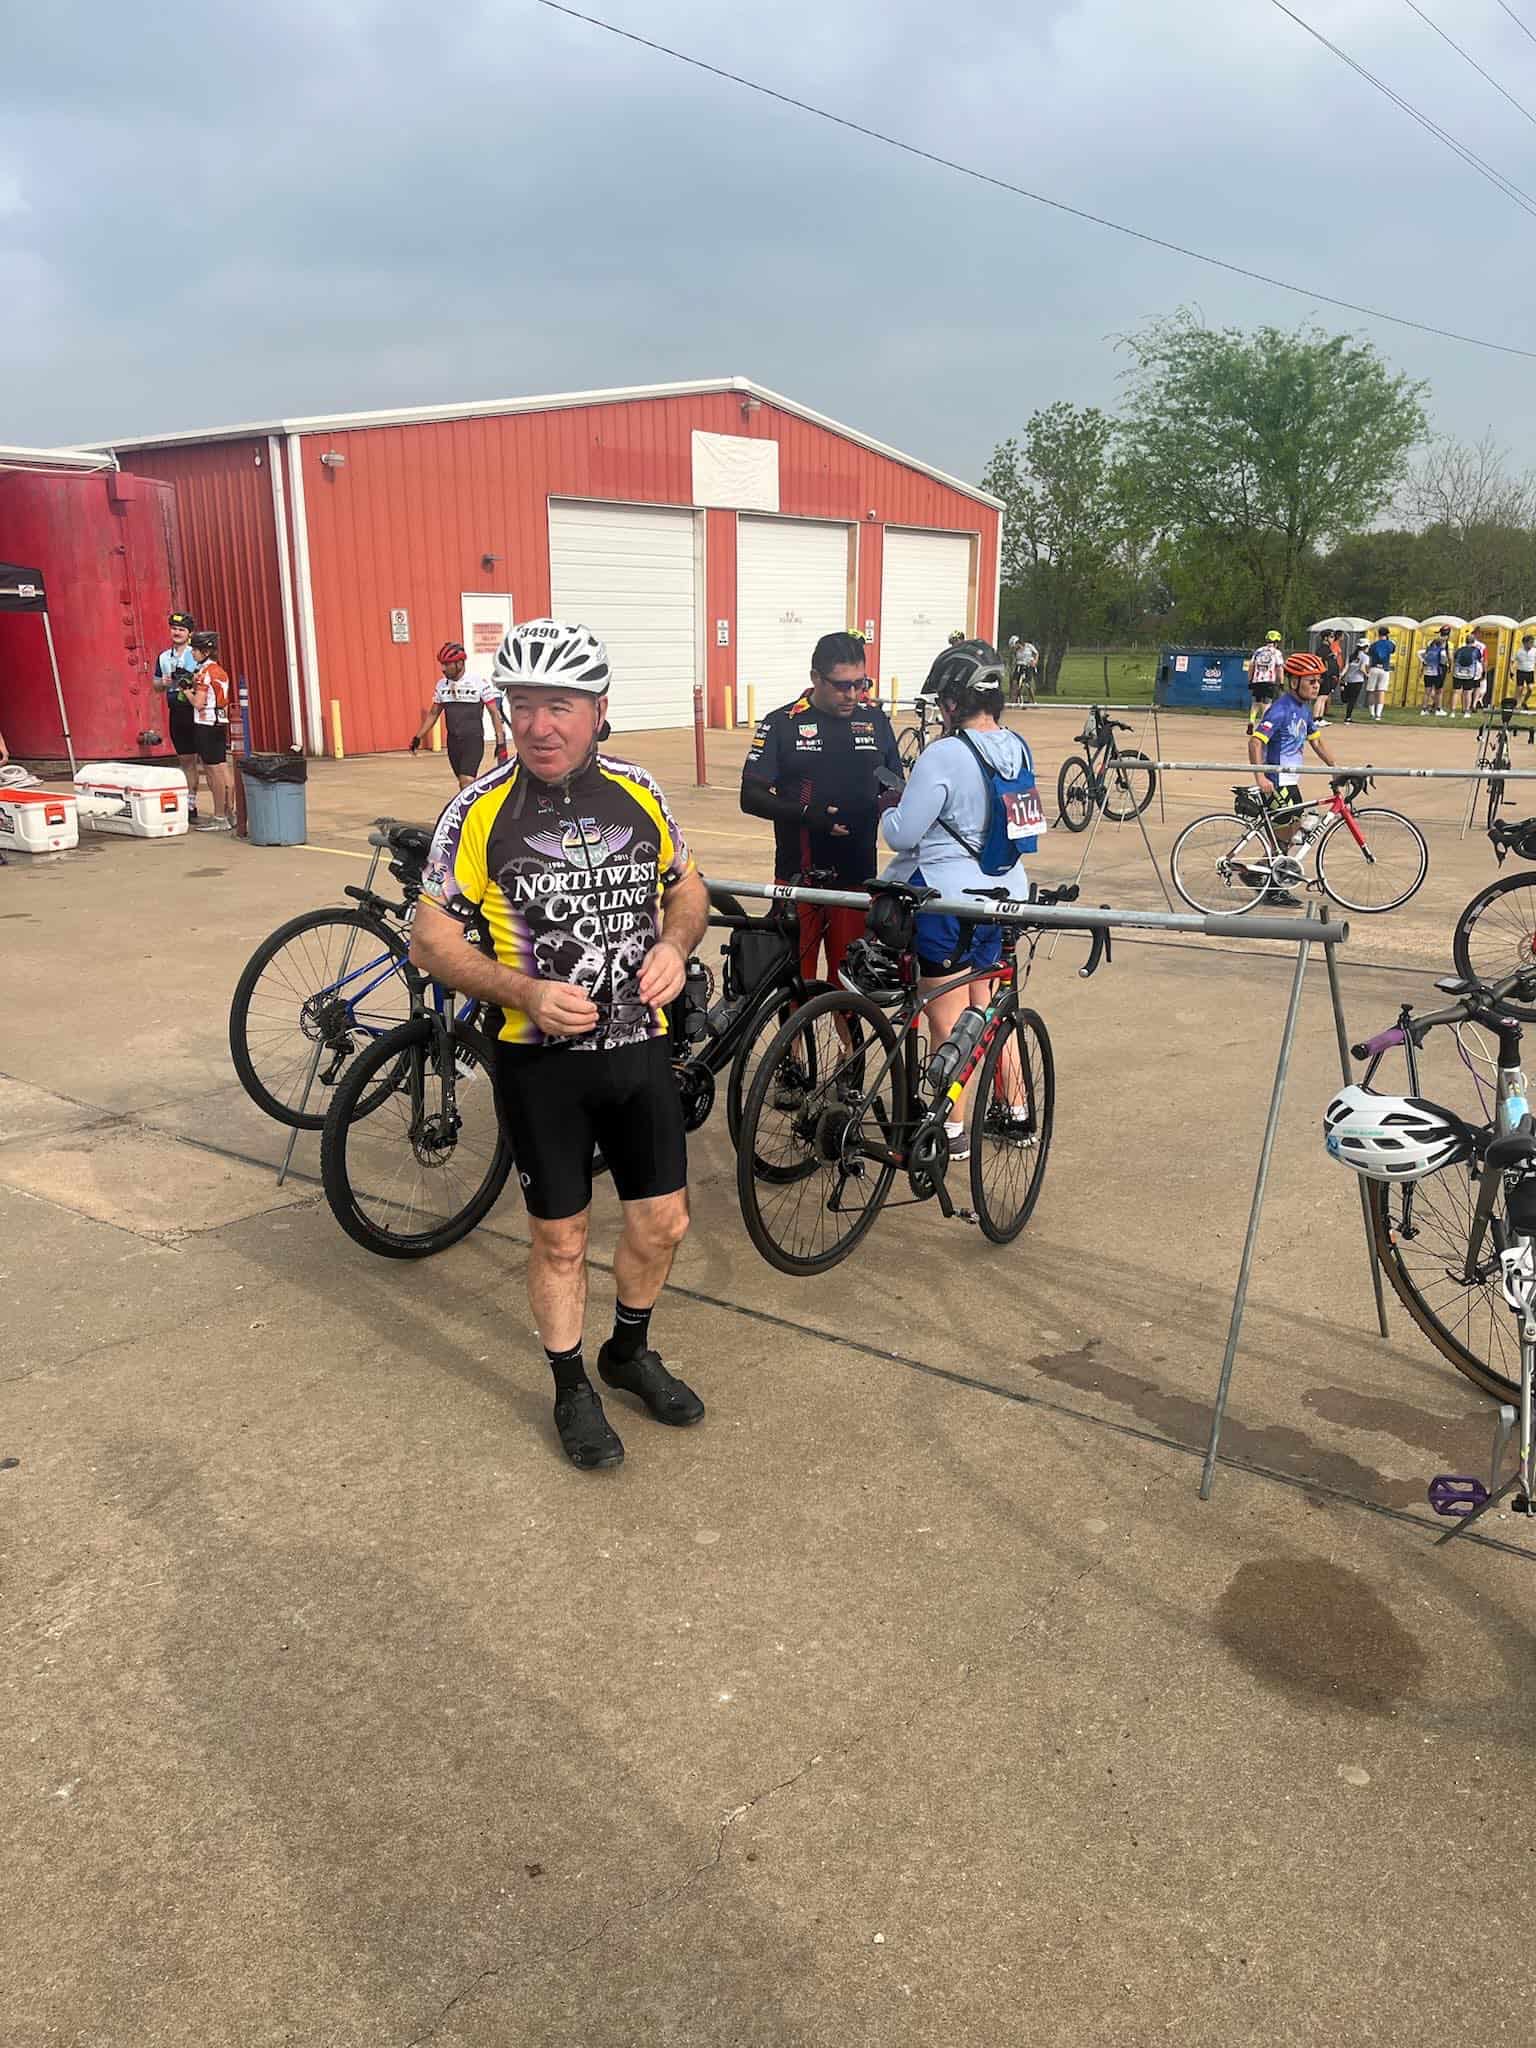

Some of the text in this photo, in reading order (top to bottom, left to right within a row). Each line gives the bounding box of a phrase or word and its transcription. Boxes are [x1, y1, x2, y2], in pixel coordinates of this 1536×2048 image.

[520, 627, 560, 639] 3490
[559, 817, 601, 847] 25
[513, 862, 657, 902] NORTHWEST
[545, 886, 648, 922] CYCLING
[573, 911, 634, 943] CLUB
